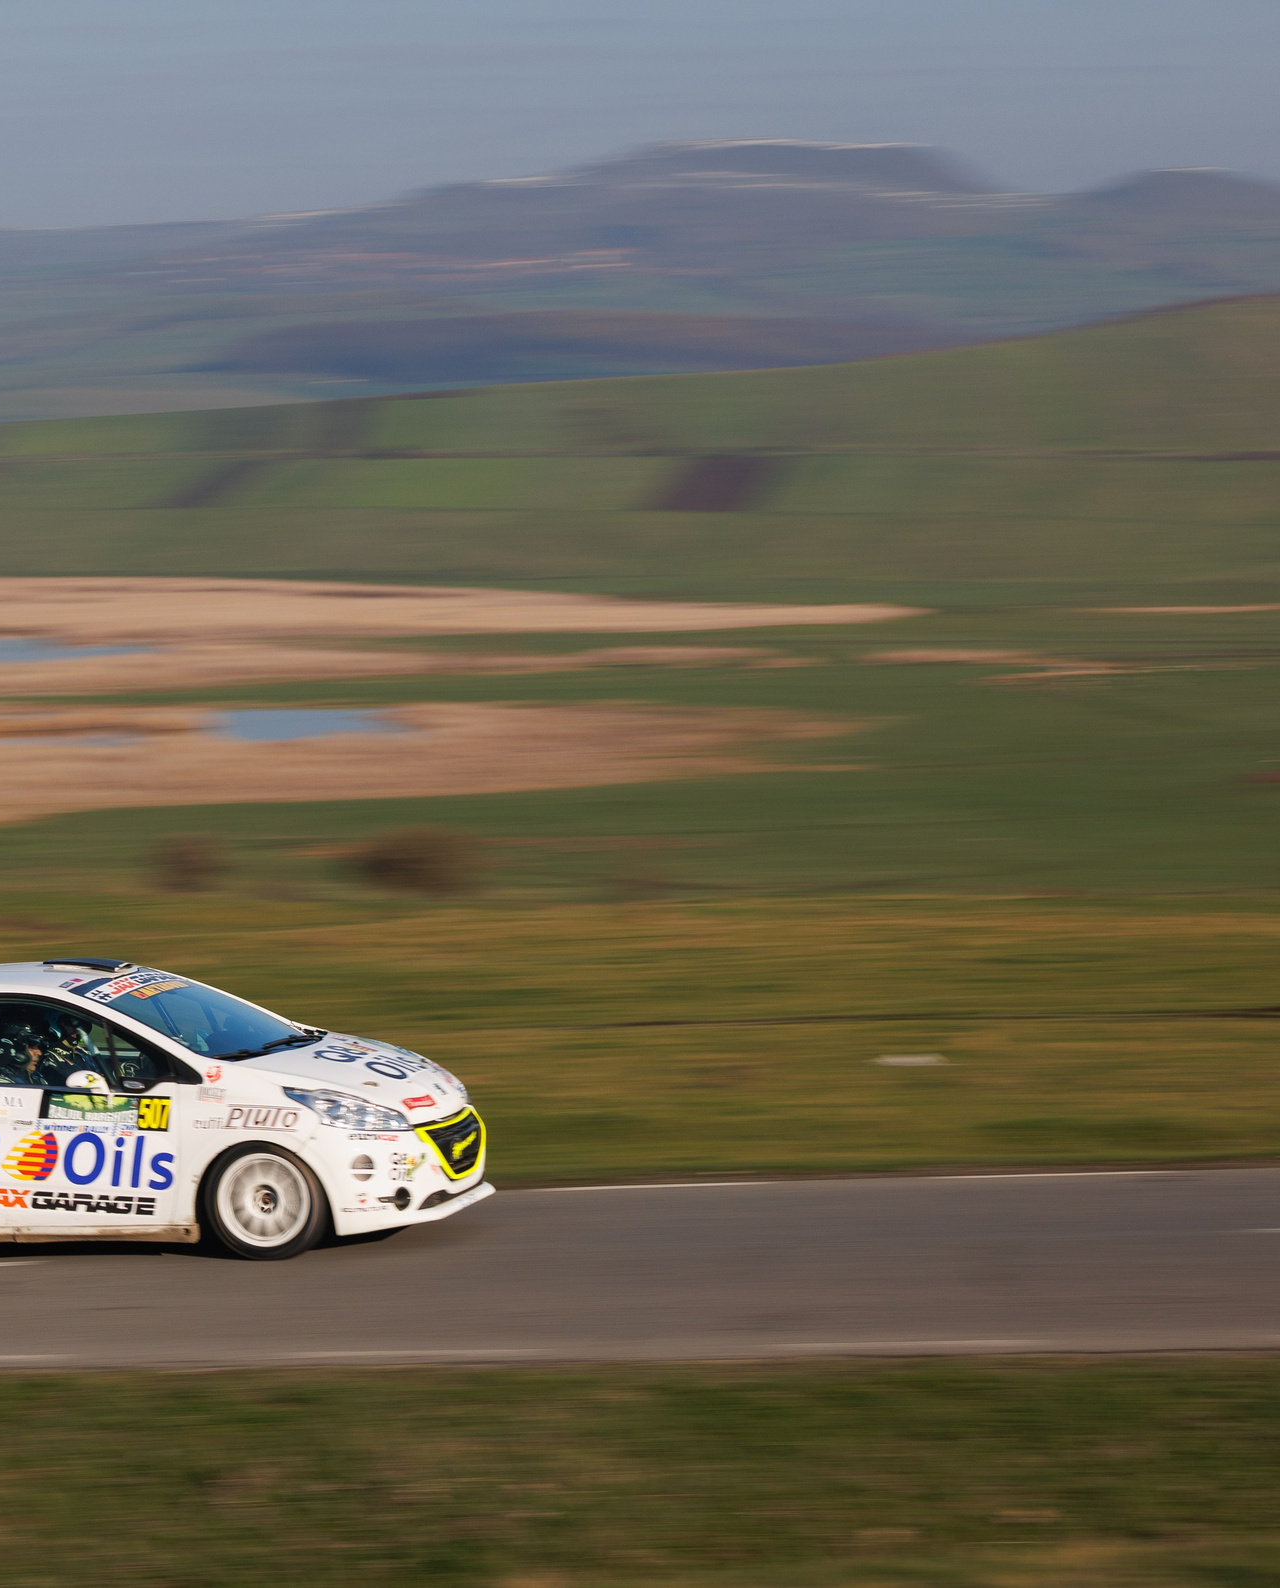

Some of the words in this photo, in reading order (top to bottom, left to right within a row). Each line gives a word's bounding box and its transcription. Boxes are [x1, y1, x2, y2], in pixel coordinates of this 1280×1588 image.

[314, 1045, 369, 1063] Q8
[138, 1098, 171, 1130] 507
[63, 1132, 175, 1190] Oils
